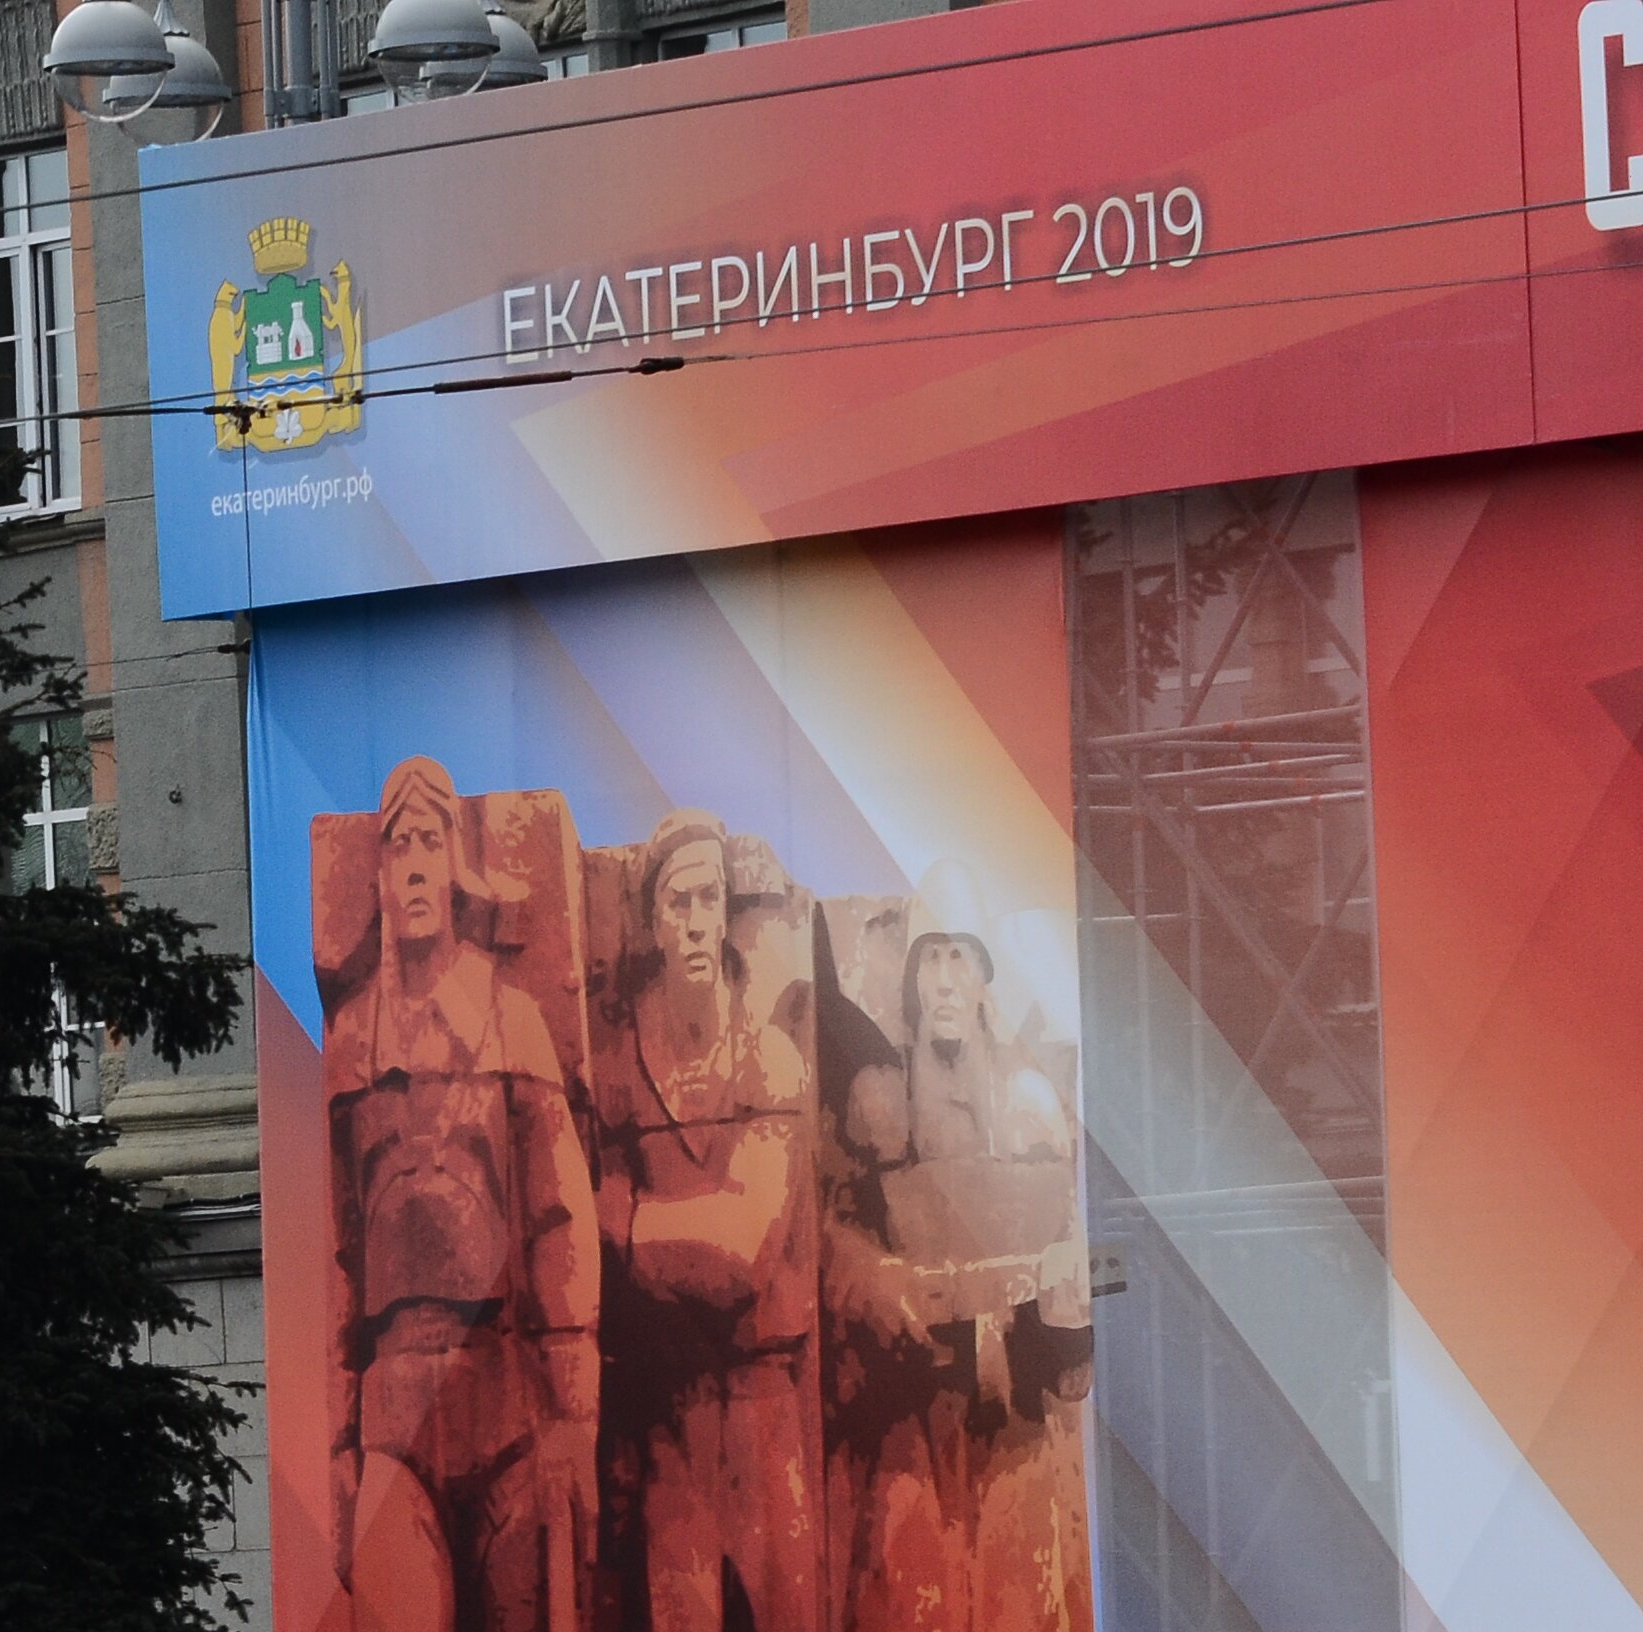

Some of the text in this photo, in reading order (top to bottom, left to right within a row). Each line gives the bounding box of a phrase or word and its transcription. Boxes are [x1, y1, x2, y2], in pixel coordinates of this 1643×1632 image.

[503, 186, 1205, 365] ЕКАТЕРИНБУРГ 2019
[211, 466, 373, 516] екатеринбург.рф
